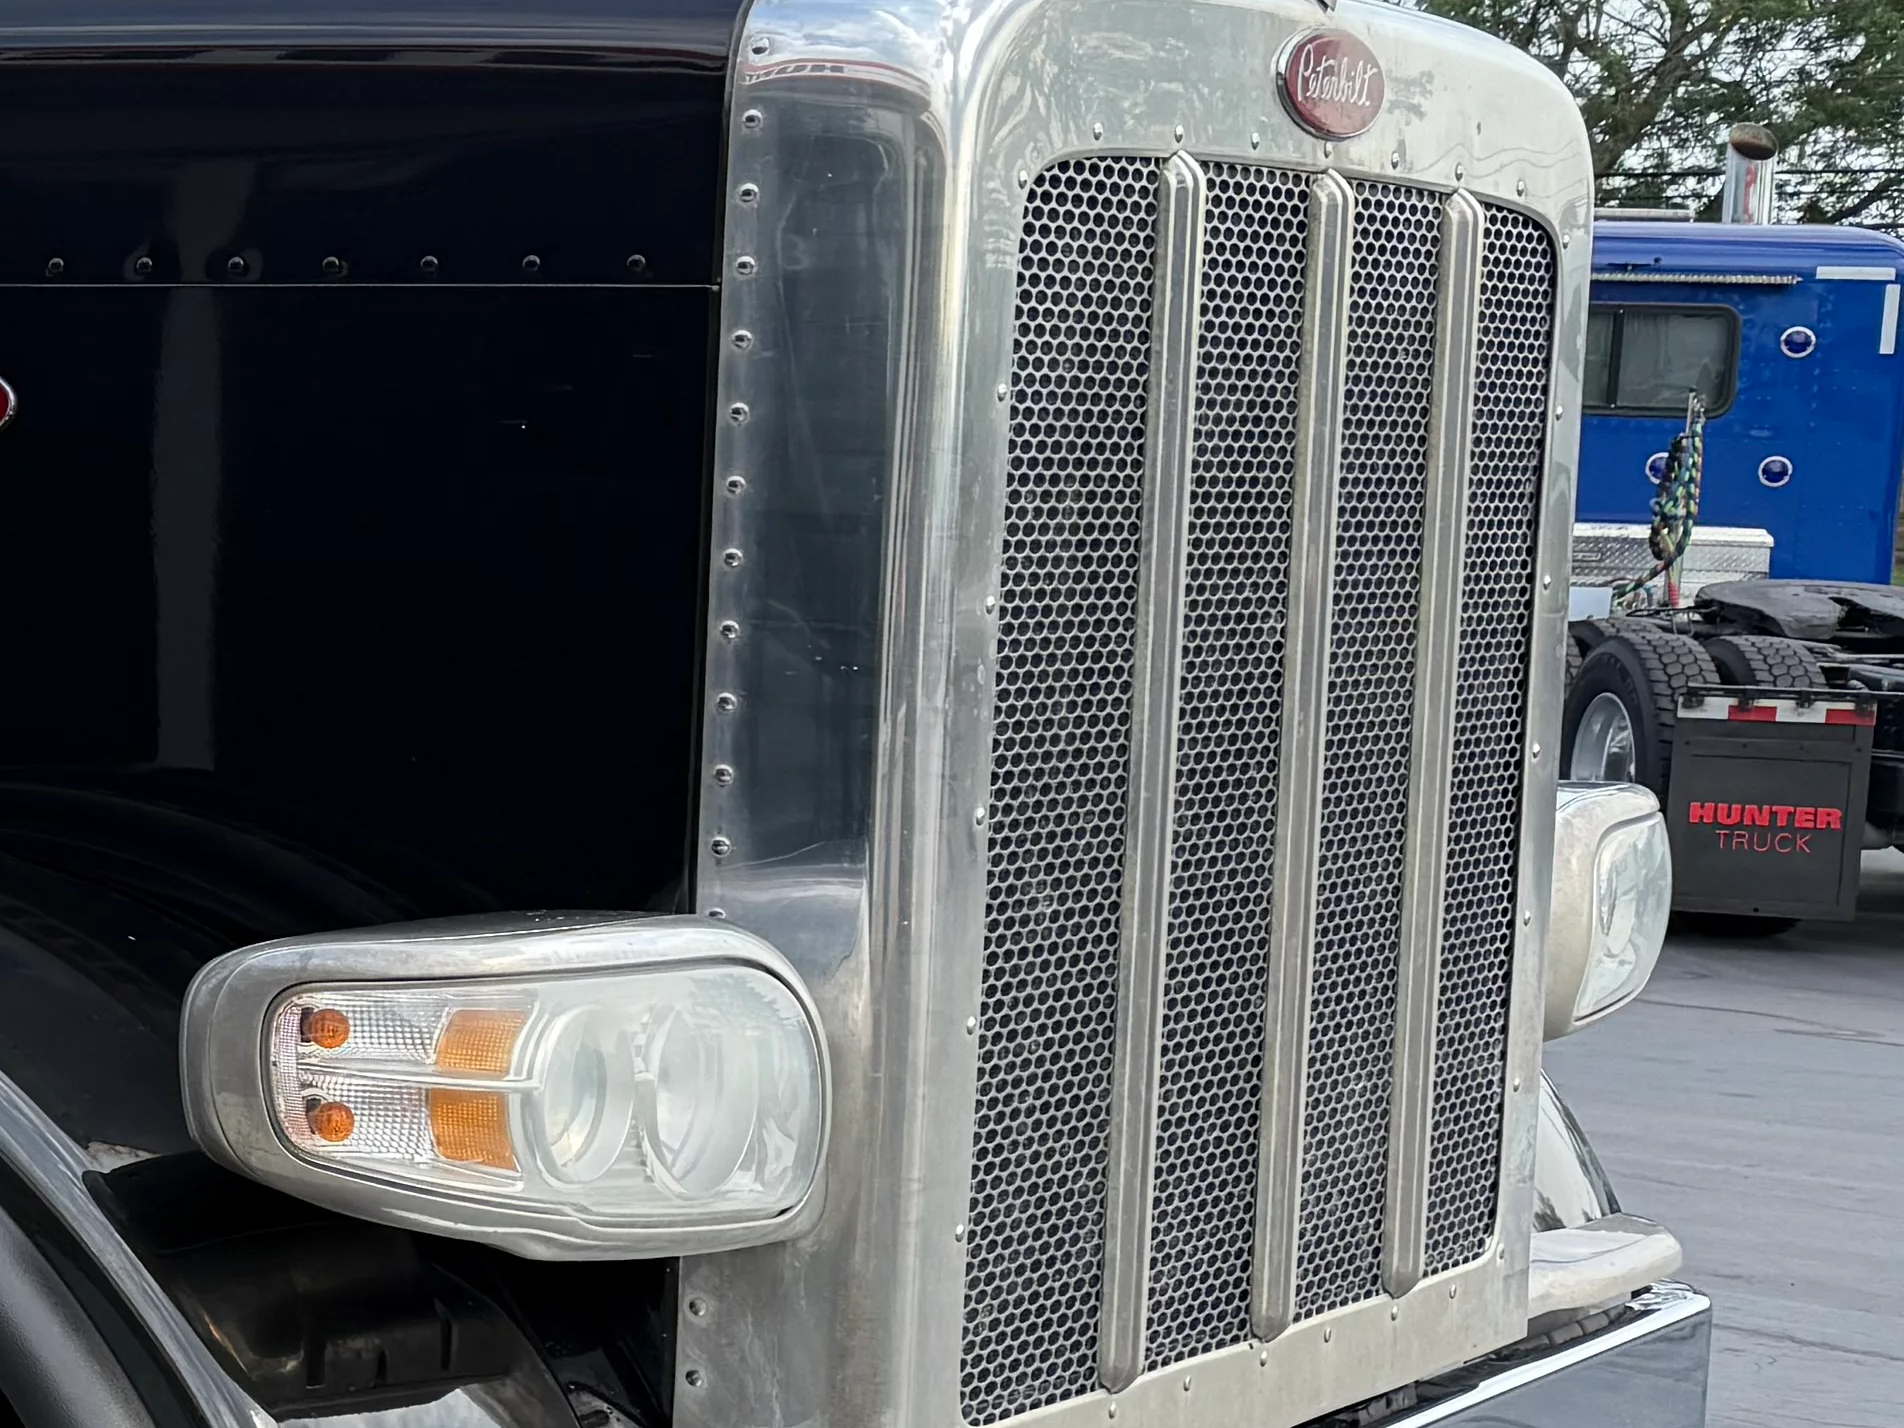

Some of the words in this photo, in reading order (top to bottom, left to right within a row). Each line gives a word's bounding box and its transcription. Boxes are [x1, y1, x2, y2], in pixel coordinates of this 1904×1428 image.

[1297, 43, 1378, 107] Peterbilt
[1689, 801, 1842, 829] HUNTER
[1715, 830, 1811, 853] TRUCK
